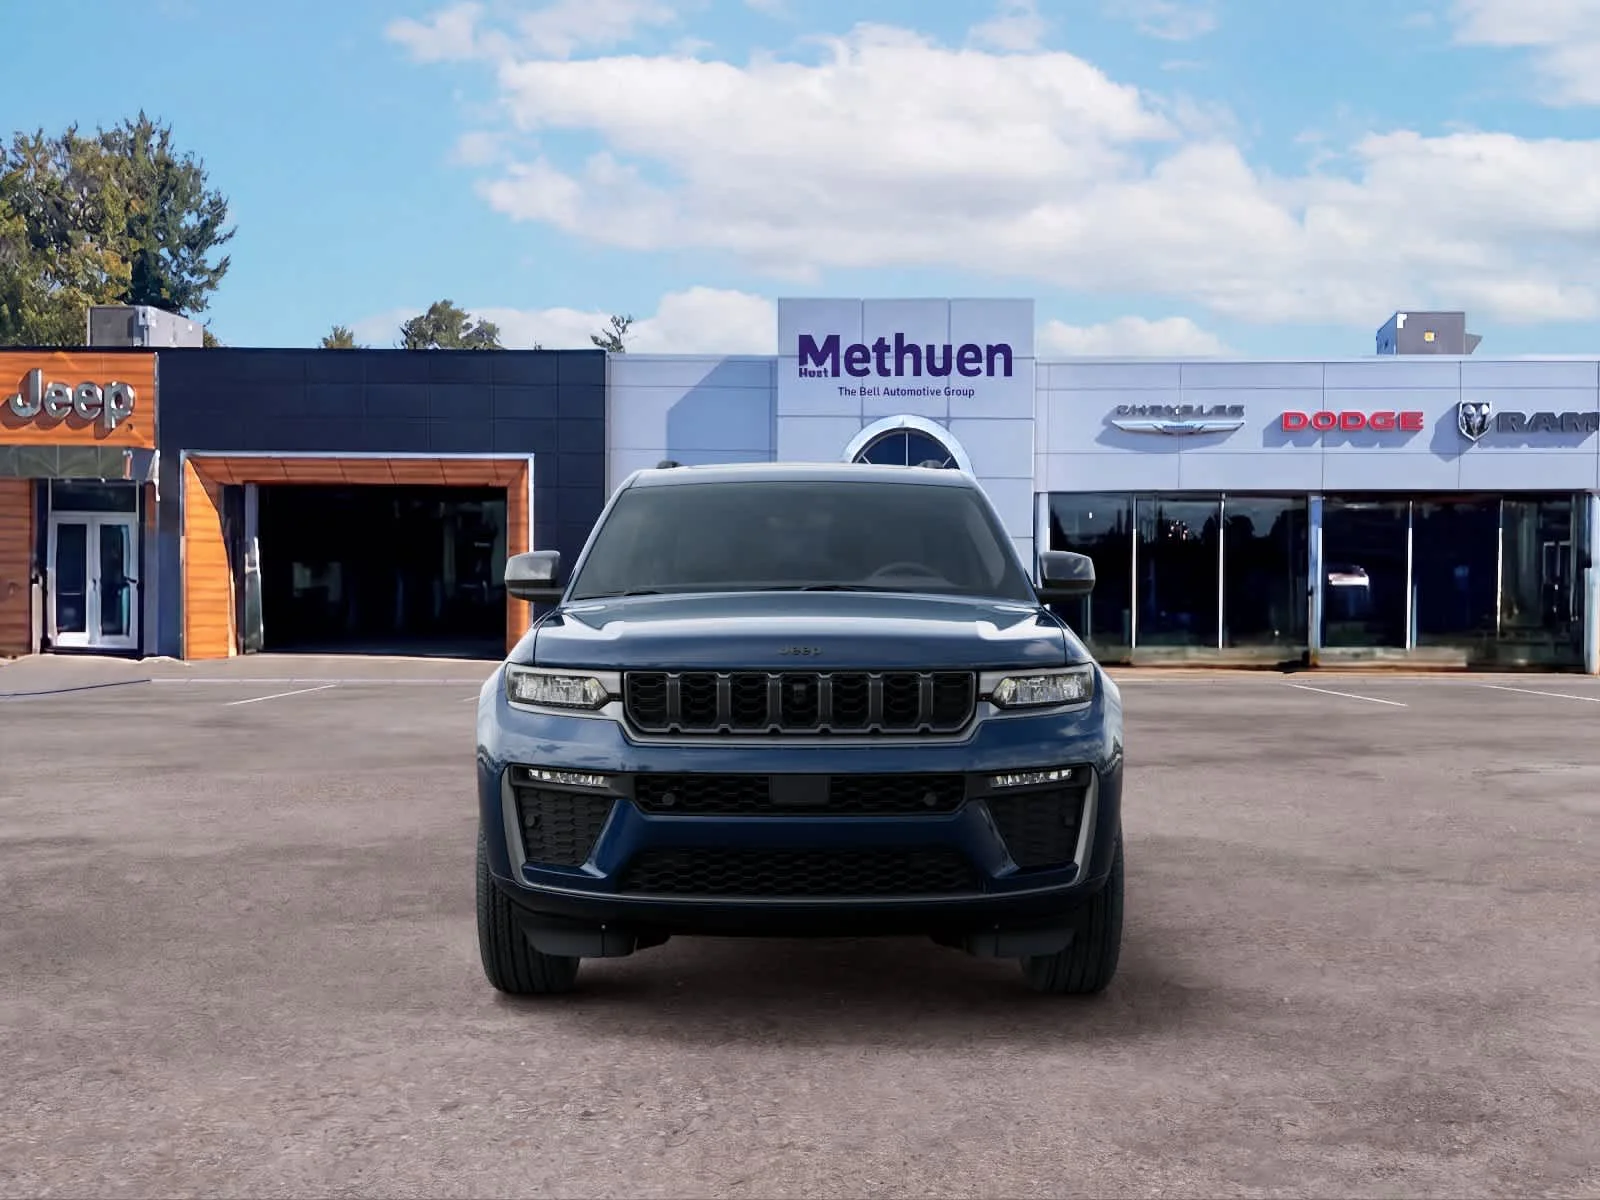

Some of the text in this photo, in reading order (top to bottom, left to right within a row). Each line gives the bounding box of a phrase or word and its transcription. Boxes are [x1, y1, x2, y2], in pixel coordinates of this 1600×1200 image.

[798, 333, 1013, 377] Methuen
[9, 368, 135, 429] Jeep
[838, 386, 975, 399] The Bell Automotive Group
[1282, 411, 1424, 431] DODGE
[1497, 411, 1600, 433] RAM
